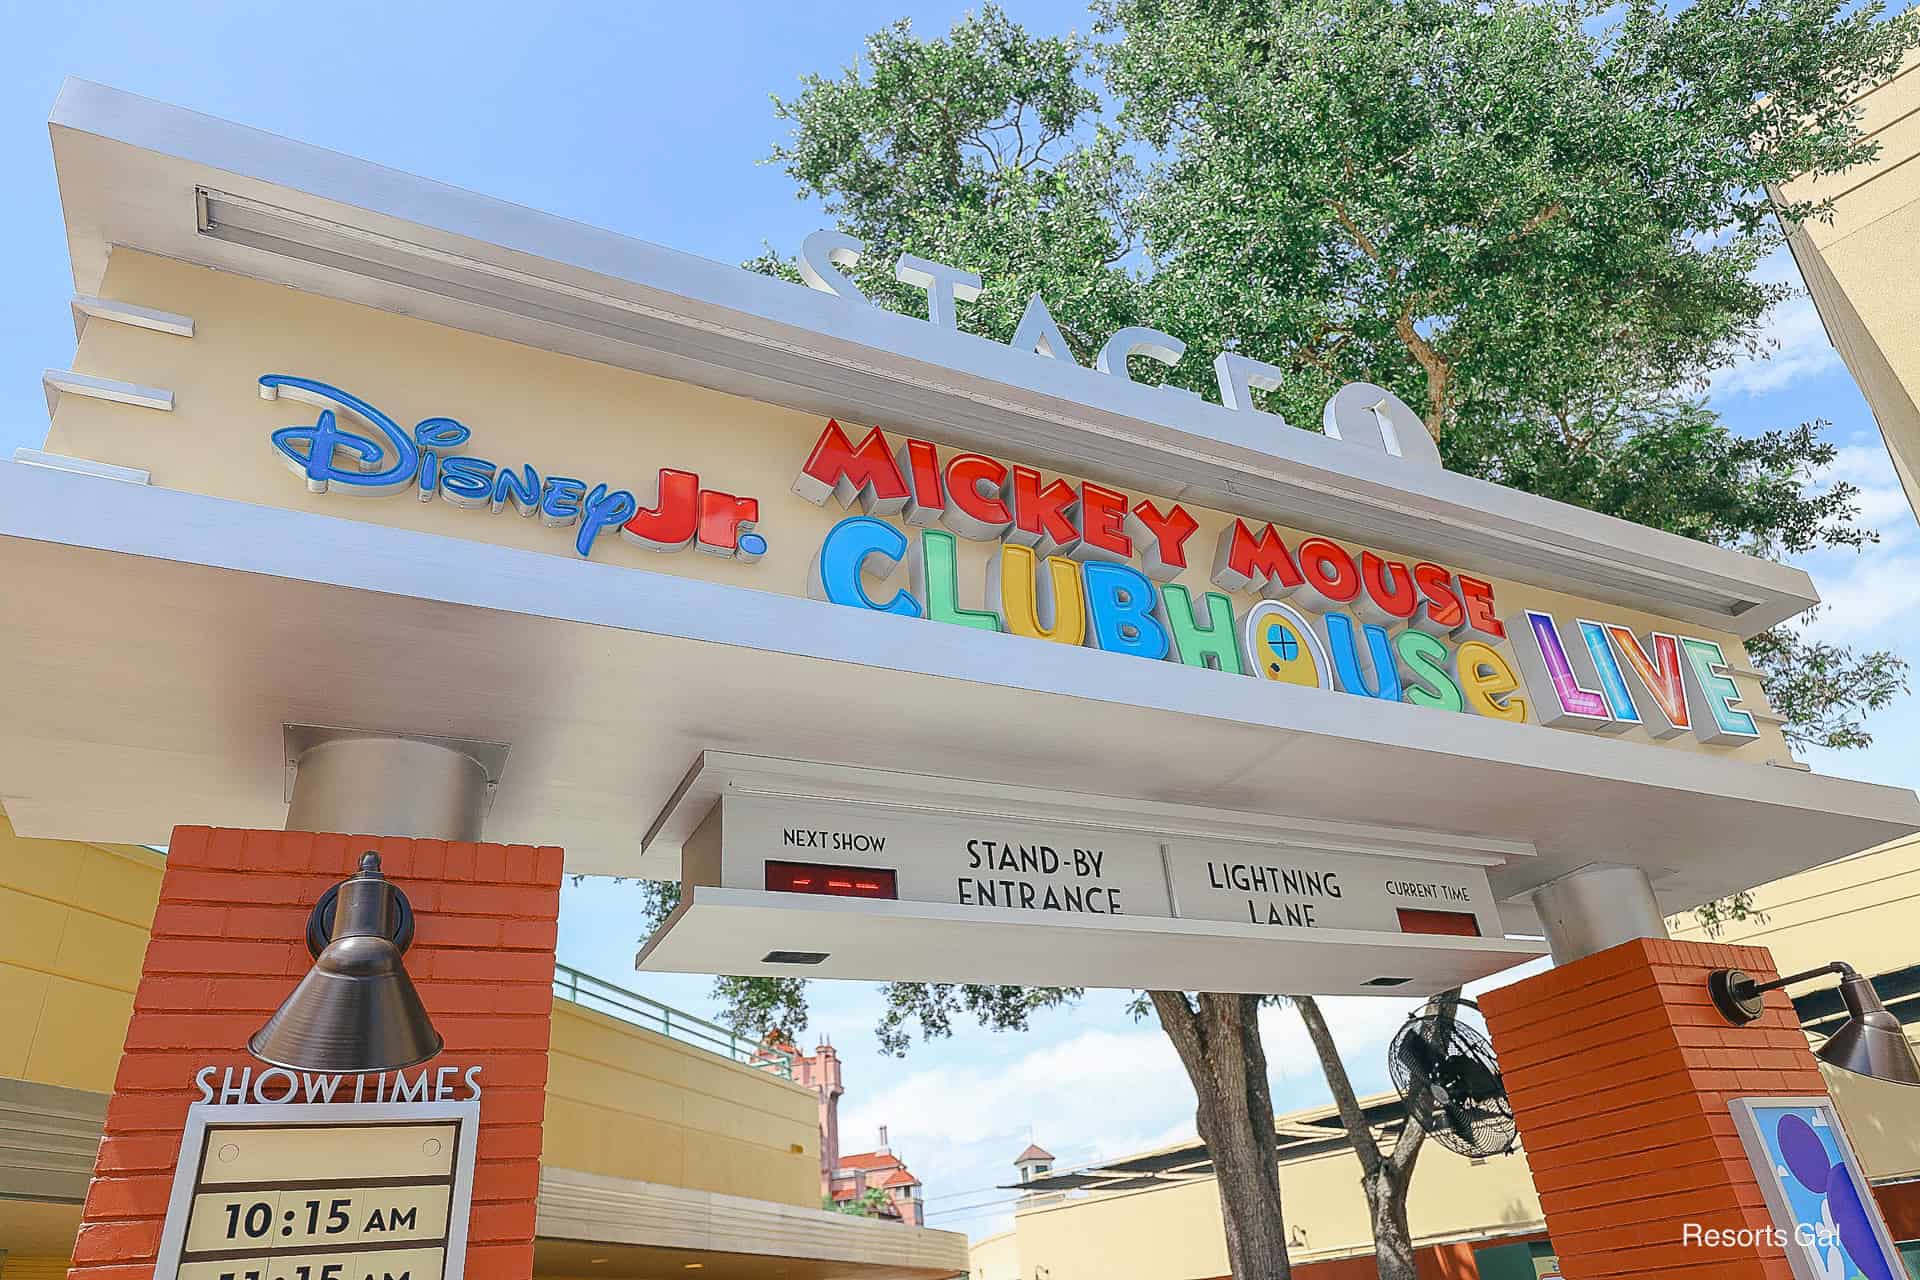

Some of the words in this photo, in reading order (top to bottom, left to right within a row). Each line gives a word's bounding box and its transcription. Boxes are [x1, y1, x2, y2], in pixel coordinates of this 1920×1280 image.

[258, 373, 636, 557] Disney
[622, 468, 768, 562] Jr.
[798, 417, 1200, 572] MICKEY
[1226, 517, 1507, 641] MOUSE
[1522, 608, 1761, 740] LIVE
[783, 828, 828, 849] NEXT
[832, 832, 886, 853] SHOW
[966, 839, 1103, 878] STAND-BY
[957, 878, 1124, 915] ENTRANCE
[1207, 862, 1342, 898] LIGHTNING
[1385, 880, 1438, 900] CURRENT
[1441, 884, 1471, 902] TIME
[1247, 900, 1318, 928] LANE
[225, 1198, 353, 1239] 10:15
[363, 1207, 417, 1232] AM
